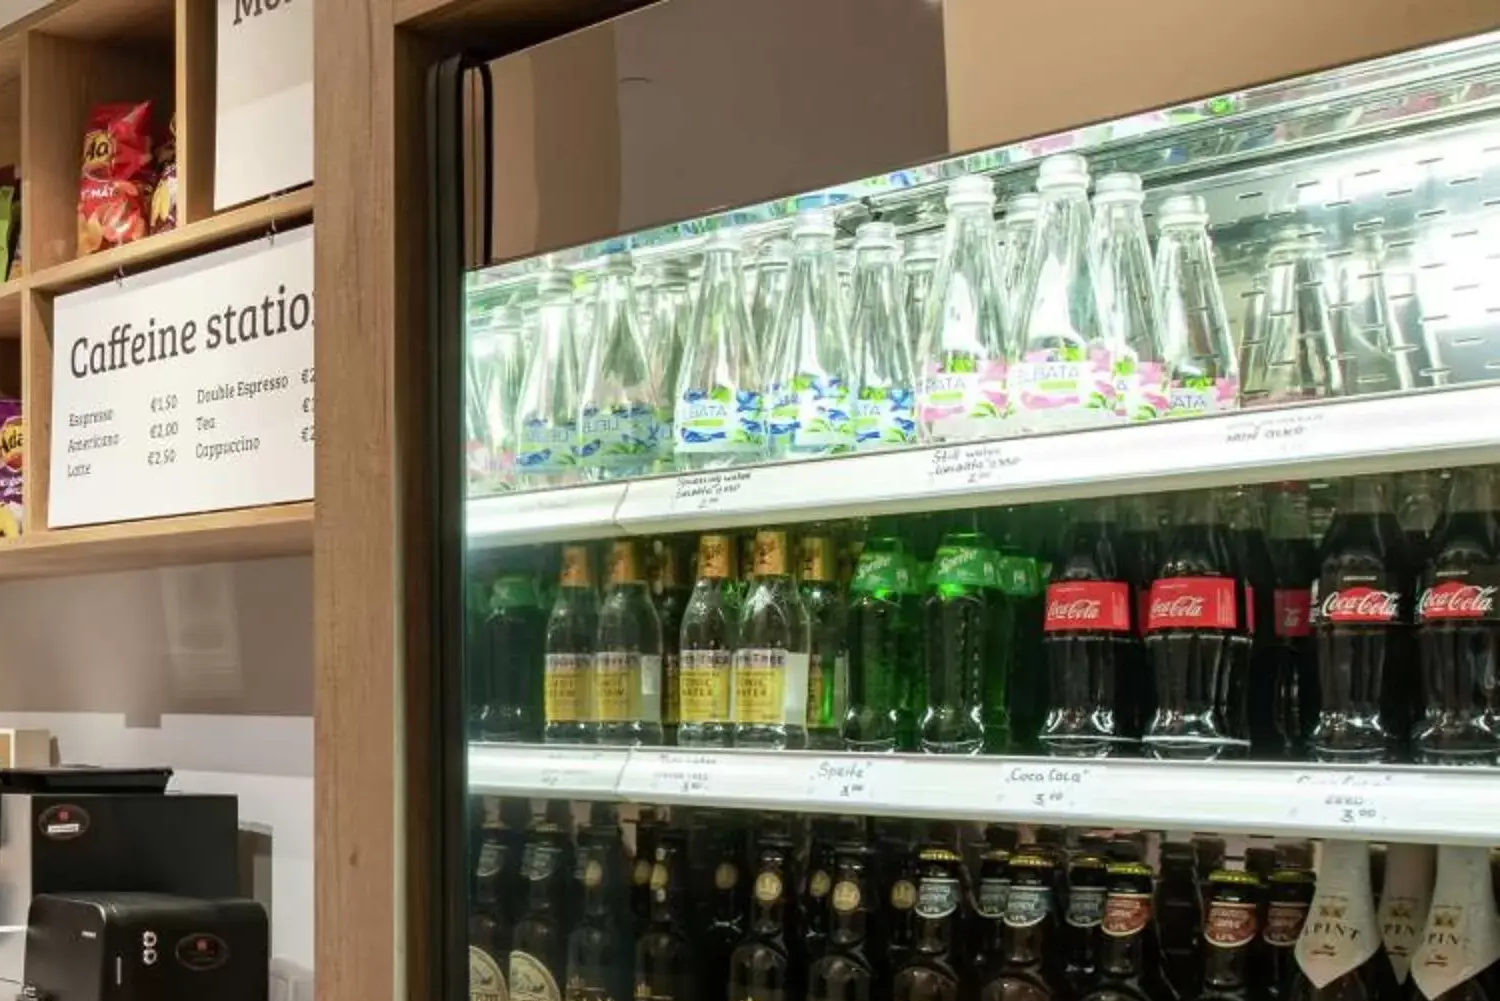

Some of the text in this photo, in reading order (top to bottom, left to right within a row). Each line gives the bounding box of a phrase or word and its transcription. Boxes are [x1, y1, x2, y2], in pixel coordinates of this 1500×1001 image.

[70, 284, 314, 379] Caffeine statio
[197, 383, 235, 405] Double
[237, 373, 289, 399] Espresso
[197, 416, 216, 431] Tea
[195, 436, 260, 461] Cappuccino
